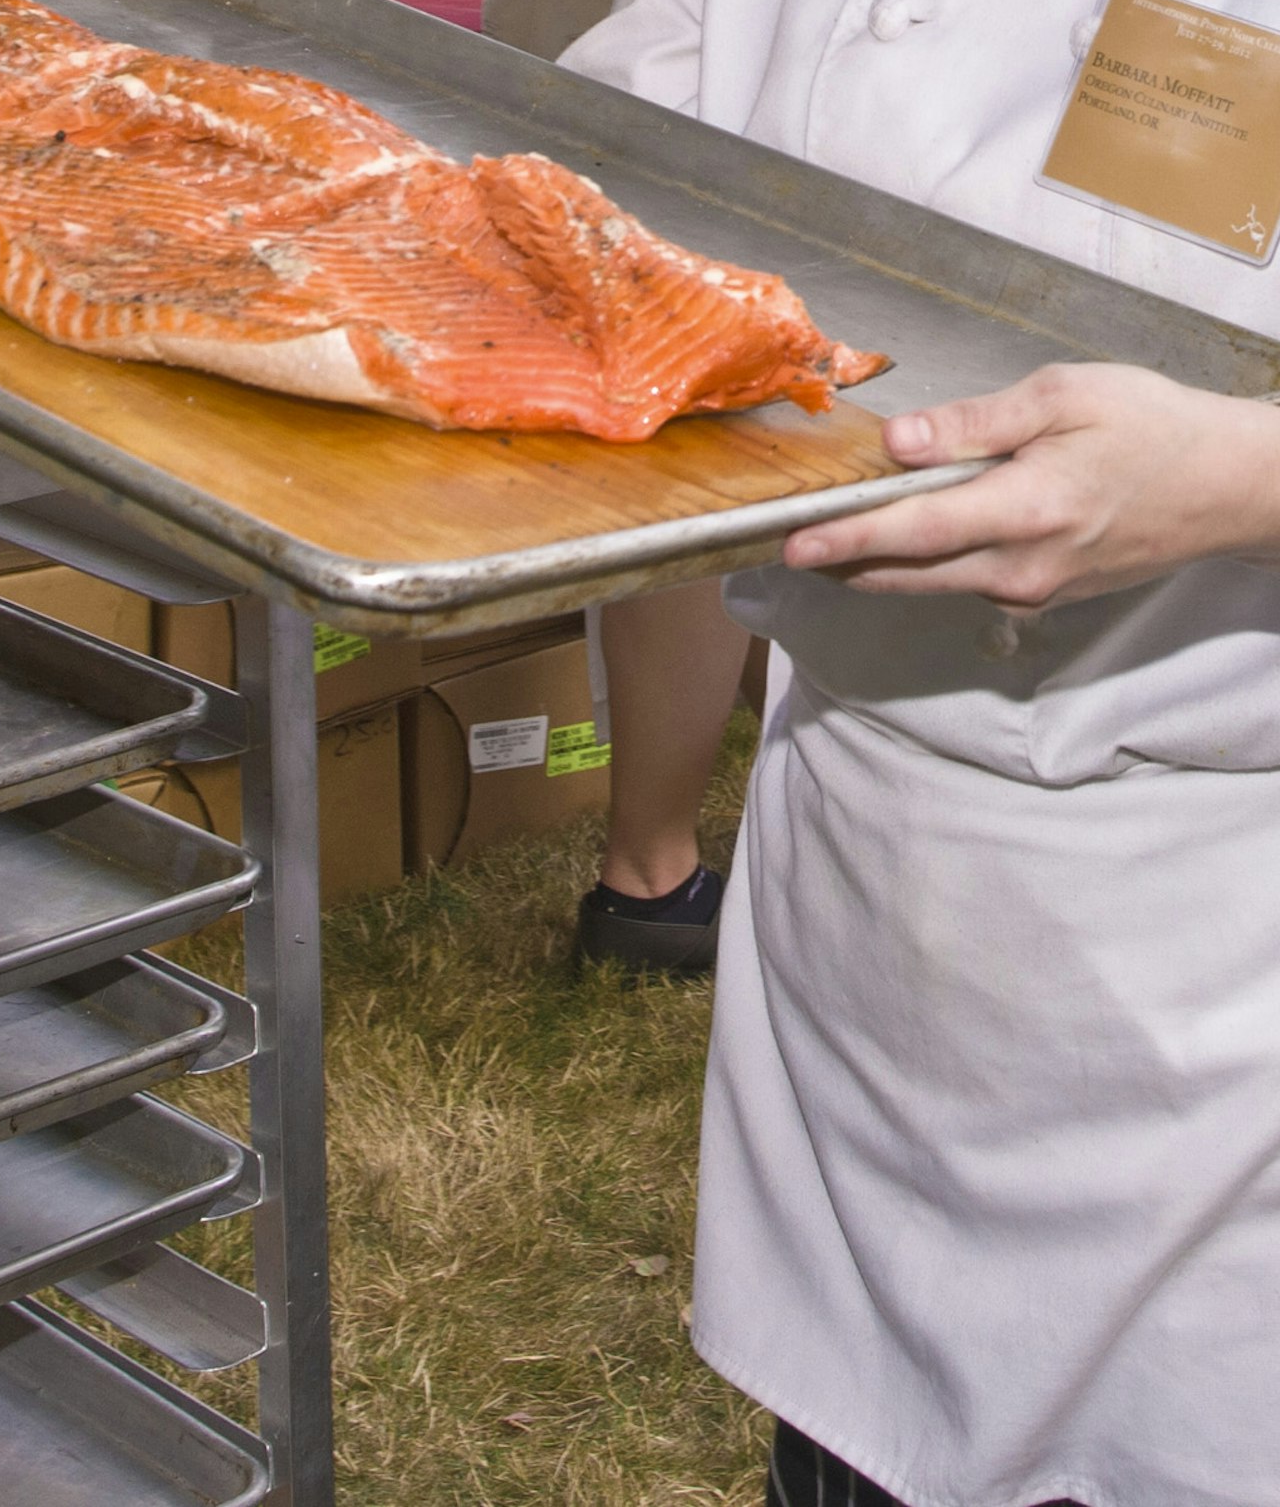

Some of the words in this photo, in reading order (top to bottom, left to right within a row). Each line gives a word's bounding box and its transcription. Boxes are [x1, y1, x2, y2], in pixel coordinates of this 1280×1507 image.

[1200, 17, 1229, 36] PINOT
[1084, 74, 1134, 100] OREGON
[1133, 90, 1193, 121] CULINARY
[1190, 111, 1249, 141] INSTITUTE
[1092, 51, 1158, 88] BARBARA
[1160, 76, 1235, 113] MOFFATT
[1077, 90, 1137, 124] PORTLAND,
[1139, 113, 1160, 130] OR
